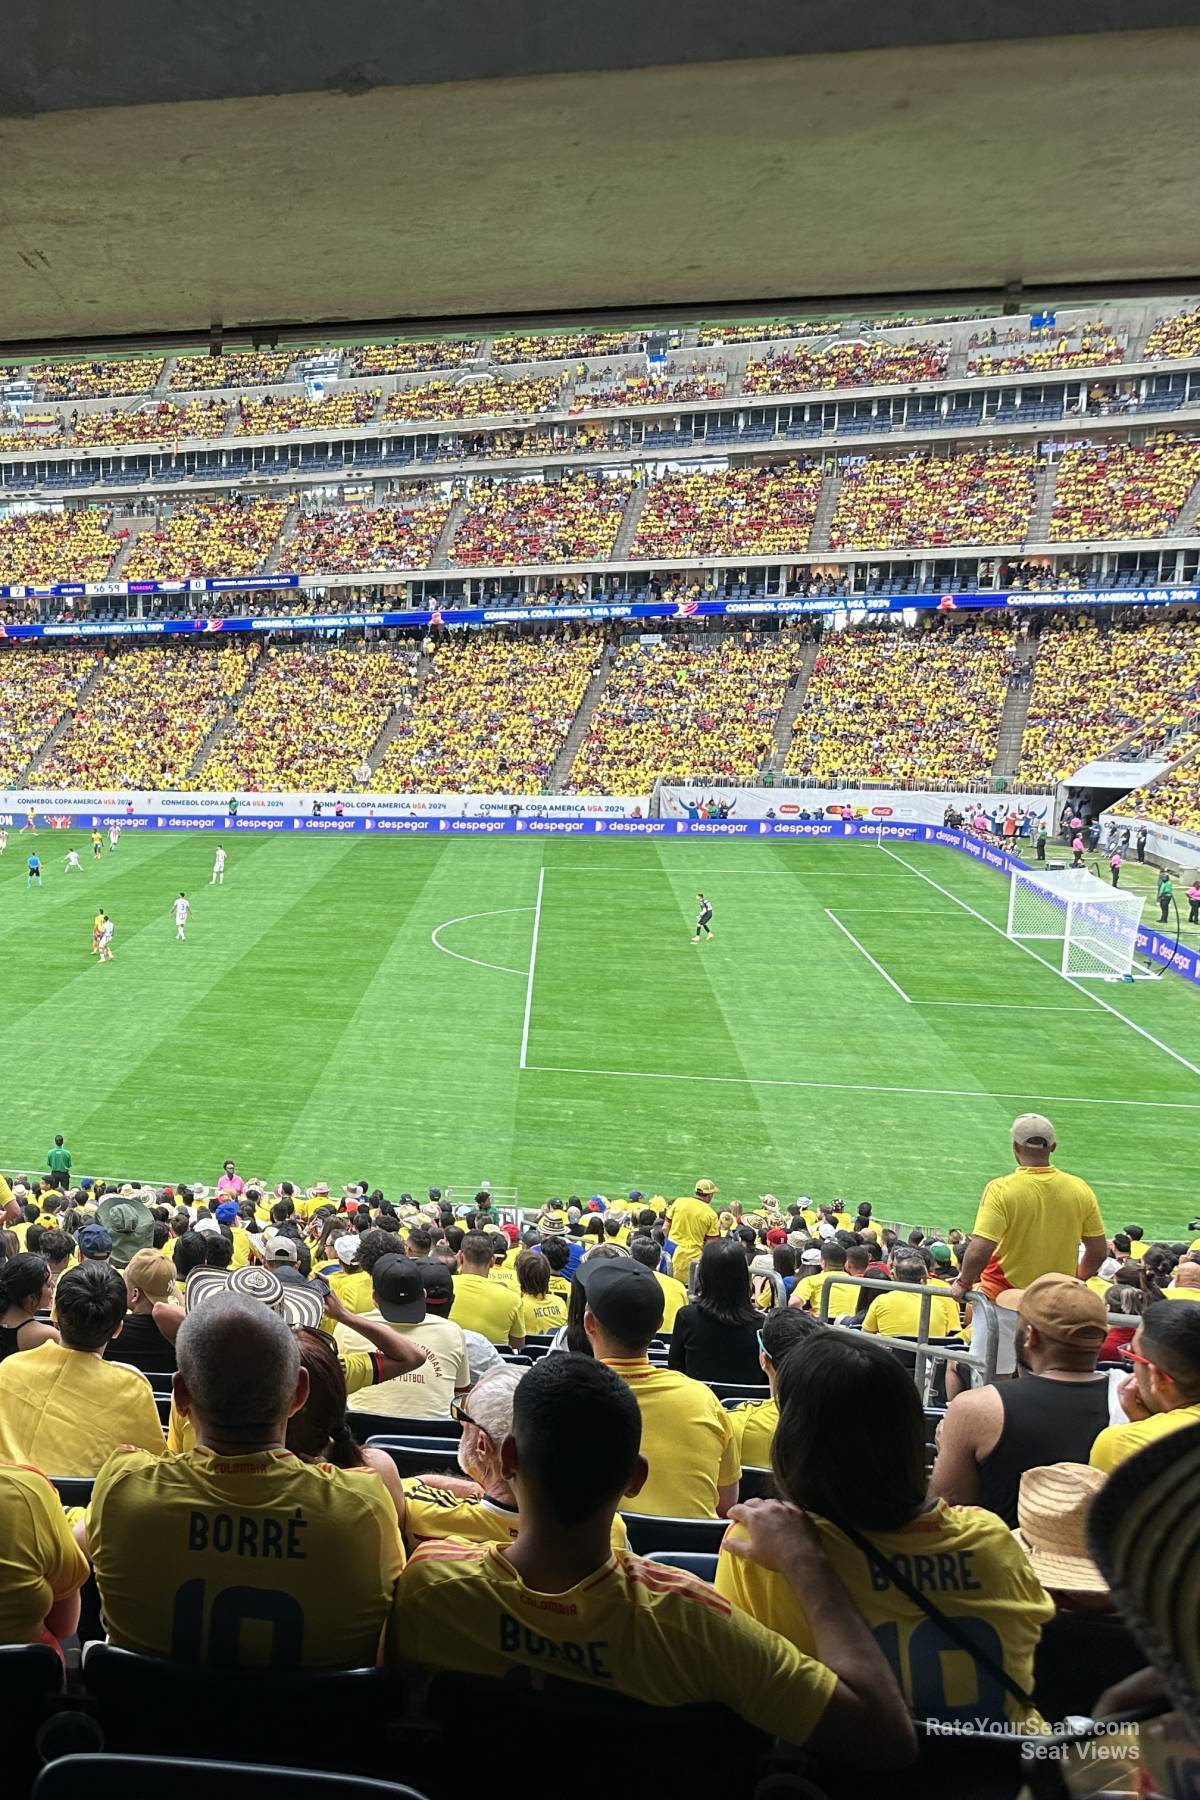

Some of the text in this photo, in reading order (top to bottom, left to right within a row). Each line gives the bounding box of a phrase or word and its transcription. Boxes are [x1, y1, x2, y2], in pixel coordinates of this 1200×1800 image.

[1007, 596, 1066, 604] CONMEBOL
[1068, 594, 1096, 603] COPA
[1097, 592, 1146, 602] AMERICA
[1147, 591, 1168, 600] USA
[726, 603, 775, 612] CONMEBOL
[777, 602, 800, 611] COPA
[801, 601, 845, 610] AMERICA
[847, 600, 865, 609] USA
[526, 804, 547, 812] COPA
[103, 817, 148, 827] despegar
[168, 818, 215, 828] despegar
[237, 818, 284, 828] despegar
[306, 819, 355, 830] despegar
[378, 820, 429, 830] despegar
[452, 820, 505, 831] despegar
[529, 820, 584, 832] despegar
[609, 822, 665, 832] despegar
[691, 822, 748, 833] despegar
[774, 824, 832, 835] despegar
[859, 824, 916, 837] despegar
[936, 830, 960, 846] despegar
[1159, 943, 1191, 970] despegar
[215, 1462, 267, 1474] COLOMBIA
[189, 1507, 308, 1560] BORRÉ
[520, 1594, 578, 1617] COLOMBIA
